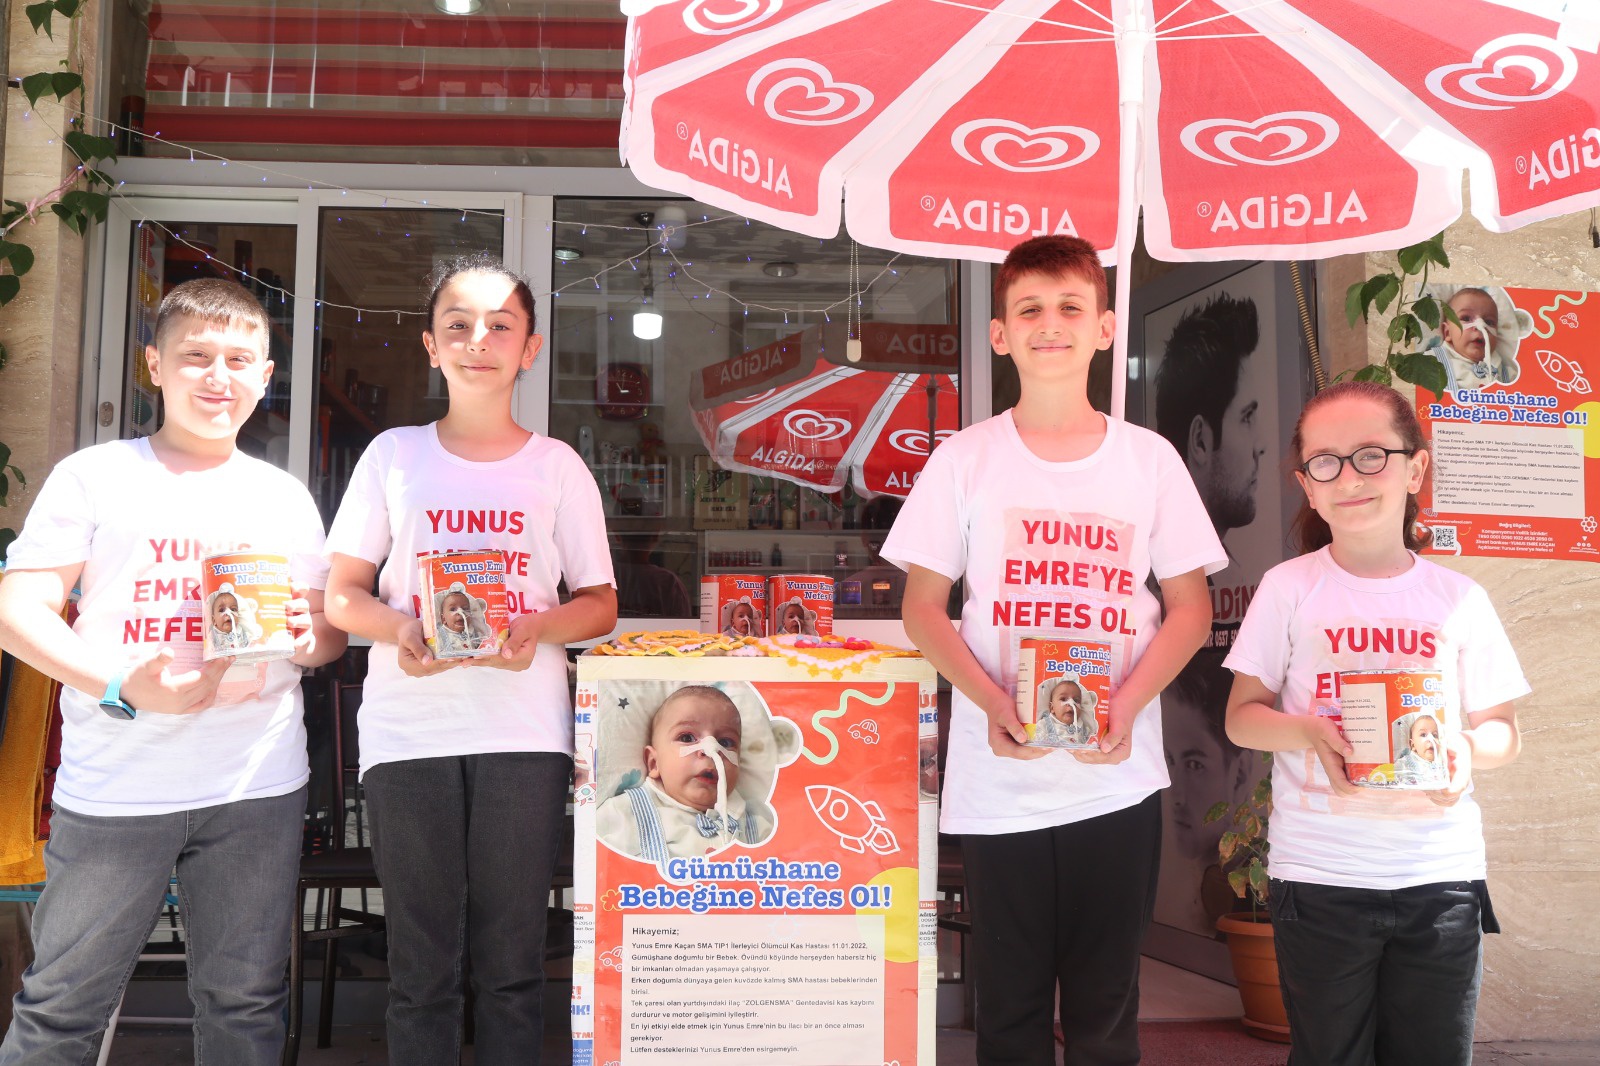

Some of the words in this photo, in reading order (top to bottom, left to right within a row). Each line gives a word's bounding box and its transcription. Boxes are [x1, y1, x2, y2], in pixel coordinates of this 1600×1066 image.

[1457, 389, 1557, 409] Gümüşhane
[1430, 404, 1508, 423] Bebeğine
[1511, 409, 1560, 424] Nefes
[1563, 412, 1588, 425] Ol!
[426, 510, 525, 535] YUNUS
[1021, 520, 1119, 552] YUNUS
[213, 561, 254, 575] Yunus
[442, 561, 485, 574] Yunus
[237, 574, 273, 585] Nefes
[468, 573, 498, 584] Nefes
[736, 580, 763, 589] Yunus
[787, 581, 818, 591] Yunus
[804, 591, 827, 601] Nefes
[992, 601, 1092, 629] NEFES
[1100, 606, 1137, 636] OL.
[1324, 627, 1436, 658] YUNUS
[1046, 661, 1104, 675] Bebeğine
[668, 858, 840, 885] Gümüşhane
[619, 886, 756, 912] Bebeğine
[763, 886, 843, 908] Nefes
[850, 885, 892, 908] Ol!
[632, 927, 680, 937] Hikayemiz;
[631, 941, 653, 949] Yunus
[654, 941, 673, 949] Emre
[674, 941, 696, 950] Kaçan
[697, 941, 713, 949] SMA
[714, 941, 729, 949] TIP1
[759, 941, 789, 949] Ölümcül
[790, 941, 804, 949] Kas
[804, 941, 830, 949] Hastası
[831, 941, 868, 949] 11.01.2022,
[630, 953, 673, 961] Gümüşhane
[672, 953, 704, 962] doğumlu
[768, 953, 798, 962] köyünde
[799, 953, 835, 962] herşeyden
[865, 953, 877, 962] hiç
[740, 965, 770, 973] çalışıyor.
[630, 976, 651, 984] Erken
[651, 976, 682, 985] doğumla
[682, 976, 713, 985] dünyaya
[713, 976, 733, 985] gelen
[763, 976, 786, 984] kalmış
[643, 999, 665, 1007] çaresi
[682, 999, 727, 1008] yurtdışındaki
[727, 999, 741, 1007] ilaç
[849, 999, 874, 1007] kaybını
[630, 1010, 661, 1018] durdurur
[693, 1011, 727, 1019] gelişimini
[727, 1010, 759, 1019] iyileştirir.
[629, 1022, 640, 1030] En
[640, 1022, 650, 1031] iyi
[650, 1022, 670, 1031] etkiyi
[670, 1022, 686, 1030] elde
[708, 1022, 722, 1030] için
[630, 1034, 664, 1043] gerekiyor.
[756, 1045, 799, 1053] esirgemeyin.
